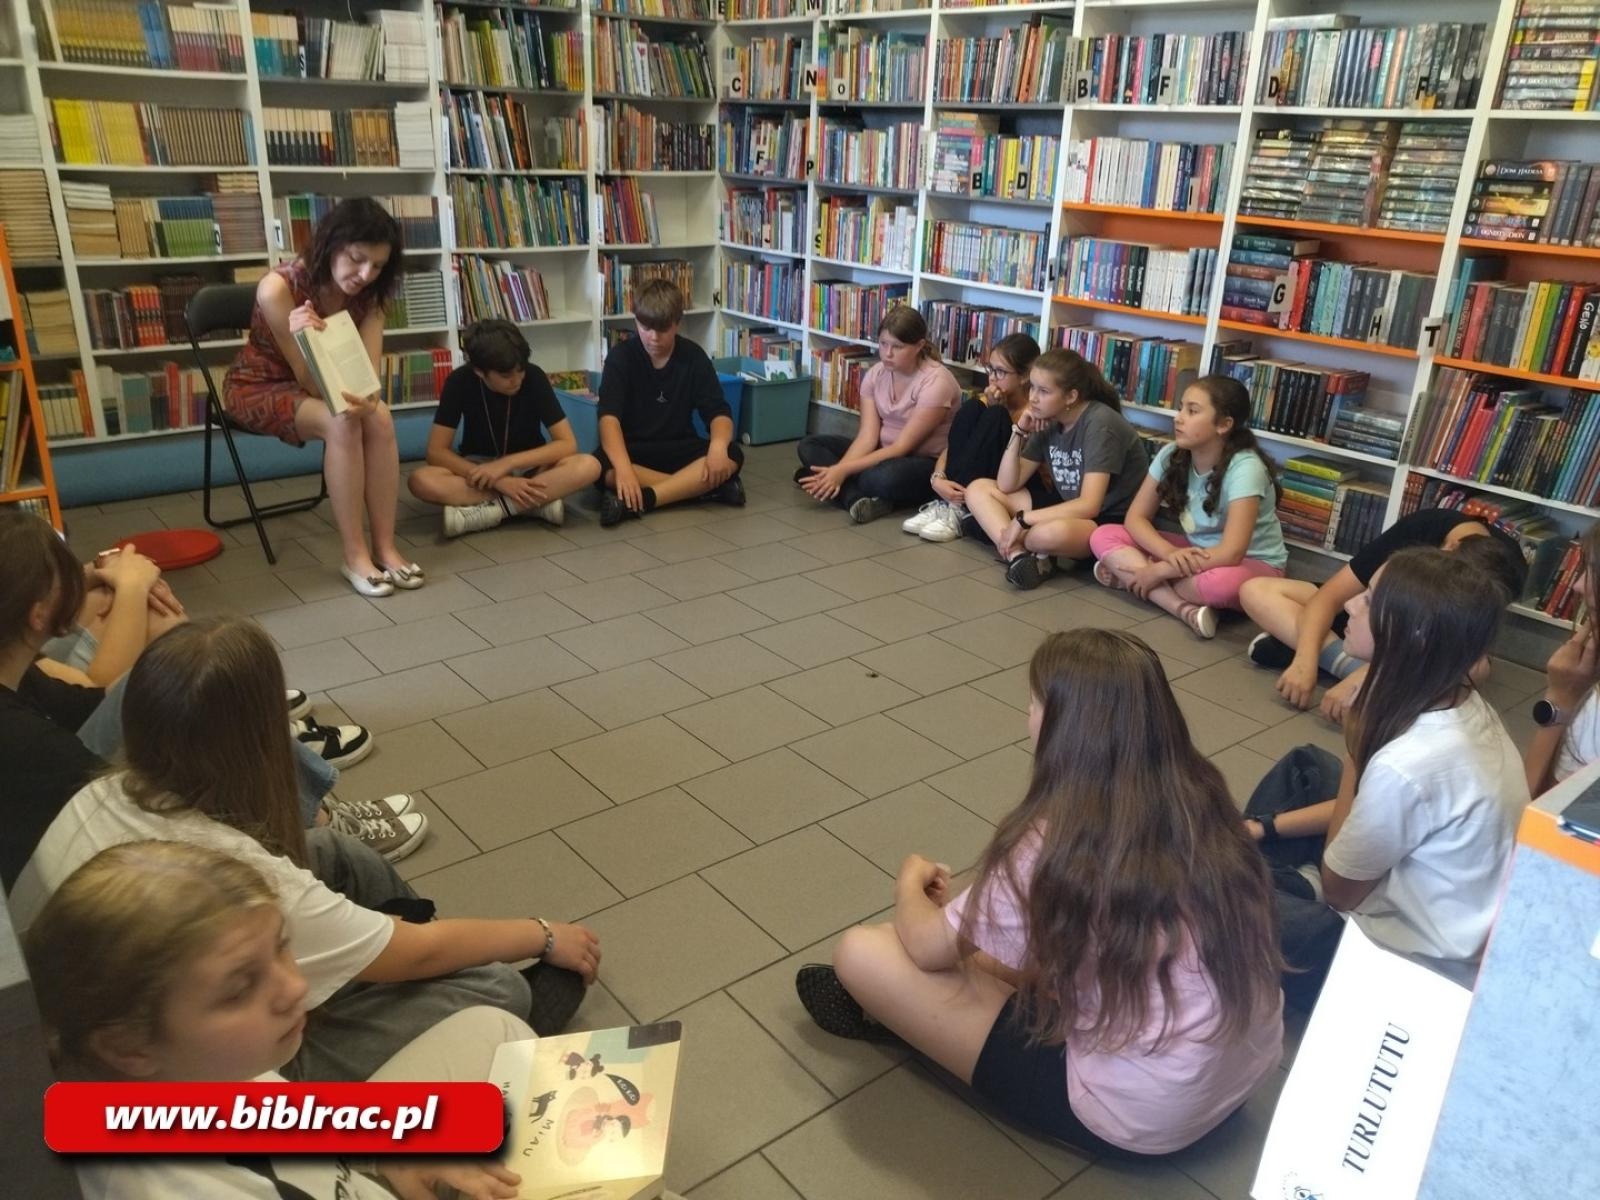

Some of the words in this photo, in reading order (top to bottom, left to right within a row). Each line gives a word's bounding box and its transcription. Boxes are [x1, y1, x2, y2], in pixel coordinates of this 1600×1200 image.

[731, 77, 741, 92] C
[806, 70, 818, 86] N
[1159, 75, 1171, 96] F
[1268, 75, 1280, 98] D
[838, 84, 846, 95] O
[1077, 78, 1088, 98] B
[756, 150, 765, 165] F
[806, 160, 814, 175] P
[972, 172, 982, 190] B
[1017, 171, 1028, 190] D
[1049, 264, 1055, 281] L
[712, 291, 720, 306] K
[1273, 283, 1286, 305] G
[1369, 314, 1382, 337] H
[1424, 325, 1441, 348] T
[1342, 1022, 1411, 1175] TURLUTUTU
[522, 1119, 555, 1157] MIAU
